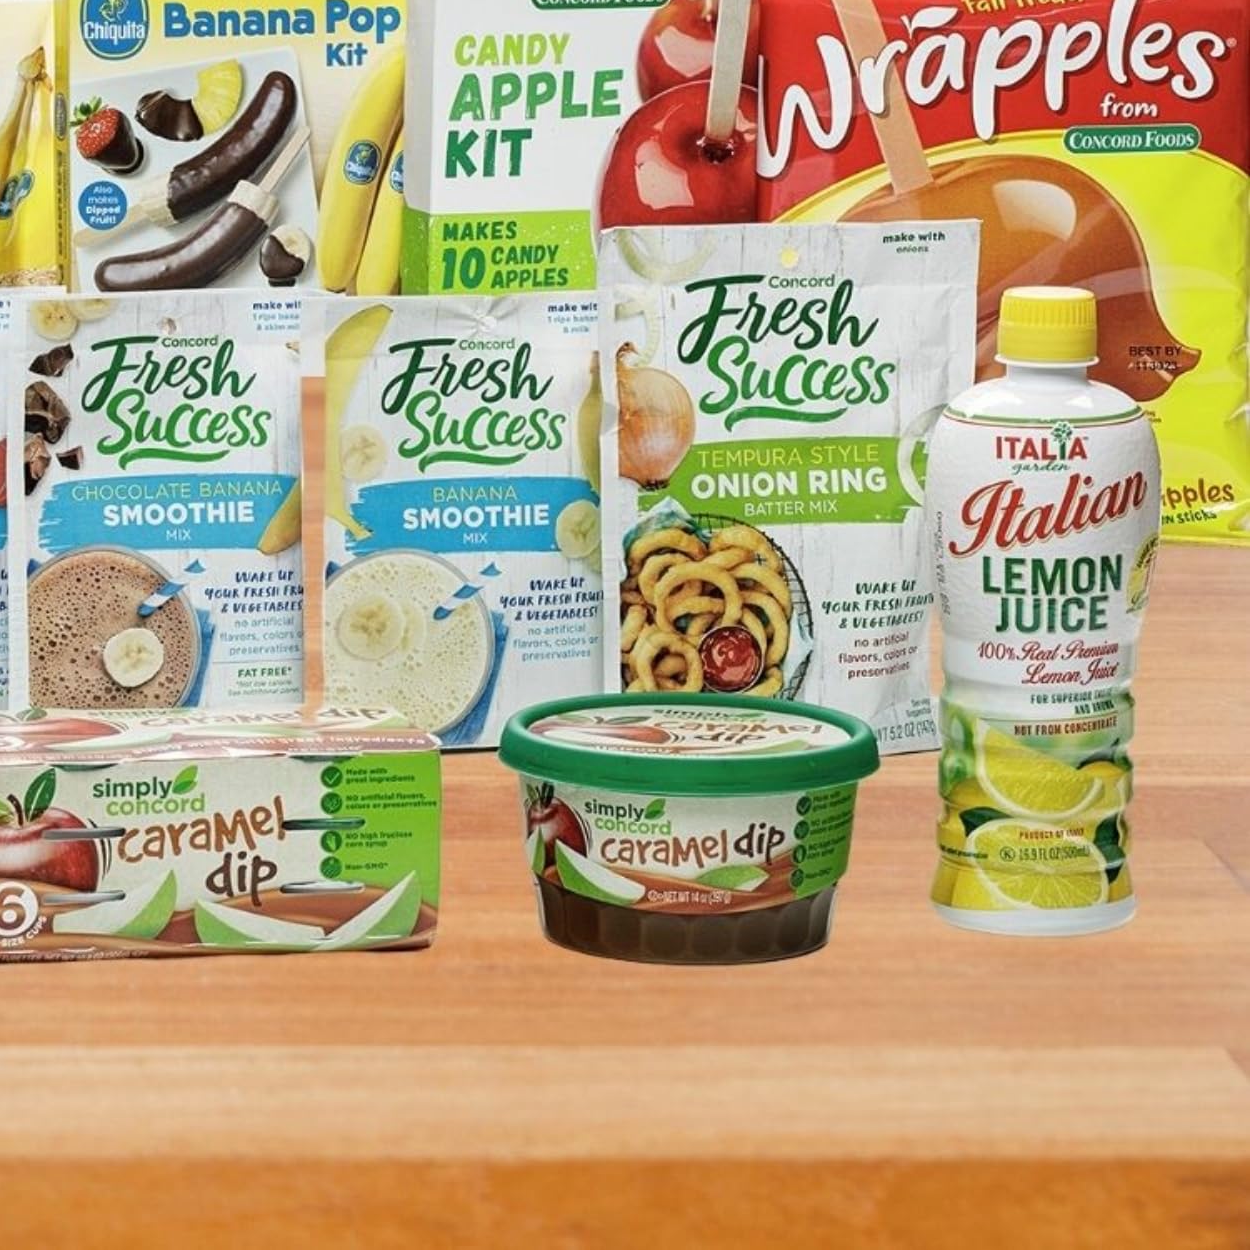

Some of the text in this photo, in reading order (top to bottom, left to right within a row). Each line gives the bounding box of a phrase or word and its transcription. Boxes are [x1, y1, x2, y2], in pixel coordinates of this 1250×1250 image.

[163, 1, 315, 38] Banana
[83, 20, 146, 47] Chiquita
[325, 42, 368, 67] Kit
[454, 32, 571, 67] CANDY
[448, 69, 624, 122] APPLE
[1100, 93, 1158, 118] from
[445, 128, 532, 179] KIT
[1068, 132, 1142, 151] CONCORD
[442, 221, 517, 242] MAKES
[882, 230, 945, 243] make with
[491, 245, 559, 265] CANDY
[441, 247, 486, 290] 10
[490, 269, 569, 288] APPLES
[768, 274, 835, 289] Concord
[252, 301, 282, 310] make
[547, 302, 577, 312] make
[677, 274, 879, 364] Fresh
[161, 335, 219, 348] Concord
[459, 338, 516, 351] Concord
[1129, 346, 1182, 356] BEST BY
[81, 336, 257, 413] Fresh
[381, 338, 554, 415] Fresh
[699, 335, 895, 414] Success
[96, 388, 272, 456] Success
[397, 390, 566, 458] Success
[698, 444, 879, 468] TEMPURA STYLE
[996, 430, 1087, 461] ITALIA
[1012, 461, 1070, 475] garden
[71, 480, 283, 501] CHOCOLATE BANANA
[433, 485, 518, 502] BANANA
[691, 467, 887, 499] ONION RING
[103, 501, 255, 527] SMOOTHIE
[403, 504, 550, 529] SMOOTHIE
[744, 500, 838, 516] BATTER MIX
[948, 470, 1148, 556] Italian
[165, 529, 191, 541] MIX
[462, 532, 488, 544] MIX
[982, 554, 1123, 595] LEMON
[855, 581, 897, 595] WAKE
[822, 600, 861, 614] YOUR
[995, 595, 1109, 633] JUICE
[1016, 641, 1060, 660] Real
[238, 668, 257, 677] FAT
[1021, 660, 1119, 685] Lemon Juice
[1014, 725, 1032, 736] NOT
[1035, 723, 1062, 735] FROM
[584, 798, 645, 821] simply
[594, 816, 672, 835] concord
[734, 822, 785, 863] dip
[206, 852, 278, 906] dip
